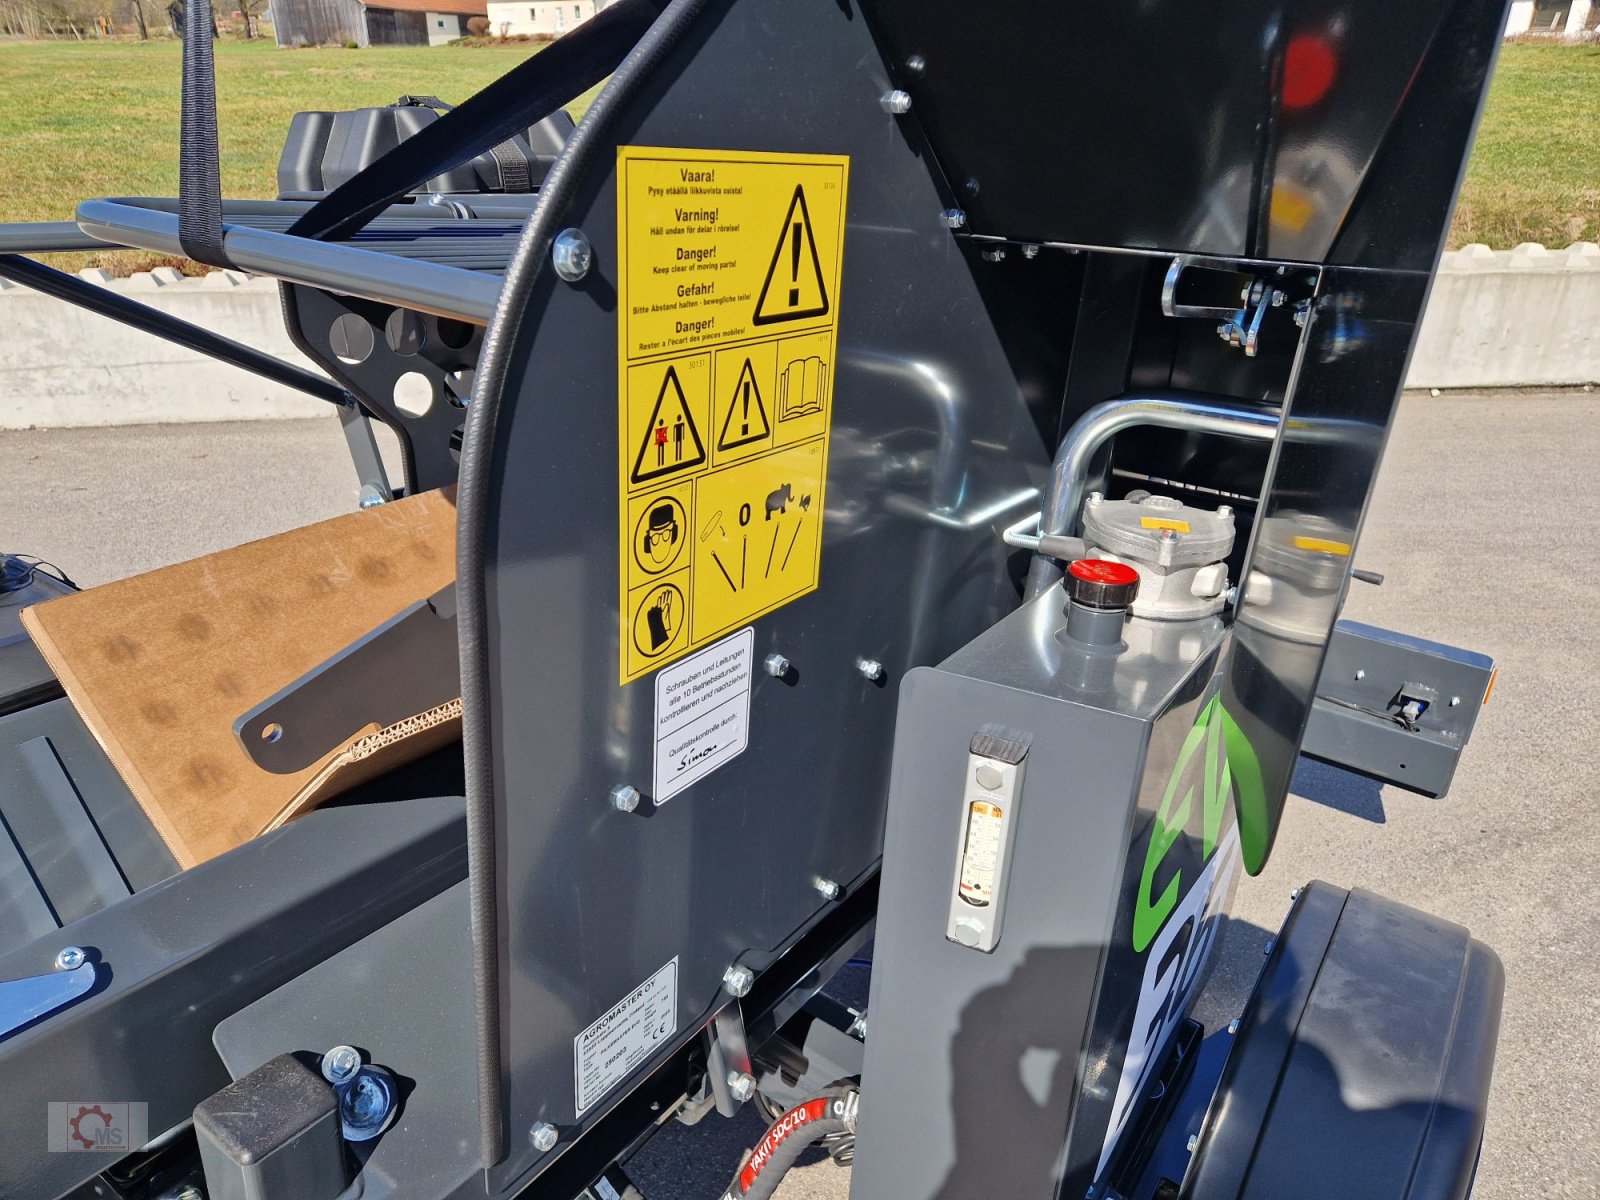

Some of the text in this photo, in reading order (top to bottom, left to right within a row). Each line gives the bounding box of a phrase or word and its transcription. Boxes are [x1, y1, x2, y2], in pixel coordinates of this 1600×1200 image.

[680, 168, 715, 183] Vaara!
[648, 186, 664, 196] Pysy
[690, 186, 721, 195] liikkuvista
[723, 186, 743, 195] osista!
[675, 207, 719, 224] Varning!
[650, 226, 663, 236] Håll
[665, 226, 685, 236] undan
[686, 225, 696, 235] för
[697, 225, 713, 234] delar
[717, 223, 740, 233] rörelse!
[676, 245, 717, 262] Danger!
[652, 260, 737, 275] Keep clear of moving parts!
[676, 282, 715, 297] Gefahr!
[632, 306, 649, 315] Bitte
[651, 302, 677, 313] Abstand
[678, 300, 698, 310] halten
[703, 296, 736, 307] bewegliche
[737, 293, 752, 302] teile!
[675, 316, 715, 334] Danger!
[639, 342, 660, 351] Rester
[667, 336, 689, 347] l'ecart
[690, 334, 701, 344] des
[702, 332, 721, 343] pieces
[722, 327, 746, 338] mobiles!
[665, 648, 745, 695] Schrauben und Leitungen
[669, 662, 742, 707] alle 10 Betriebsstunden
[660, 671, 748, 725] kontrollieren und nachziehen
[668, 712, 738, 758] Qualitätskontrolle durch:
[583, 989, 643, 1044] AGROMASTER
[644, 979, 656, 993] OY
[750, 1107, 806, 1172] YAKIT SDC/10
